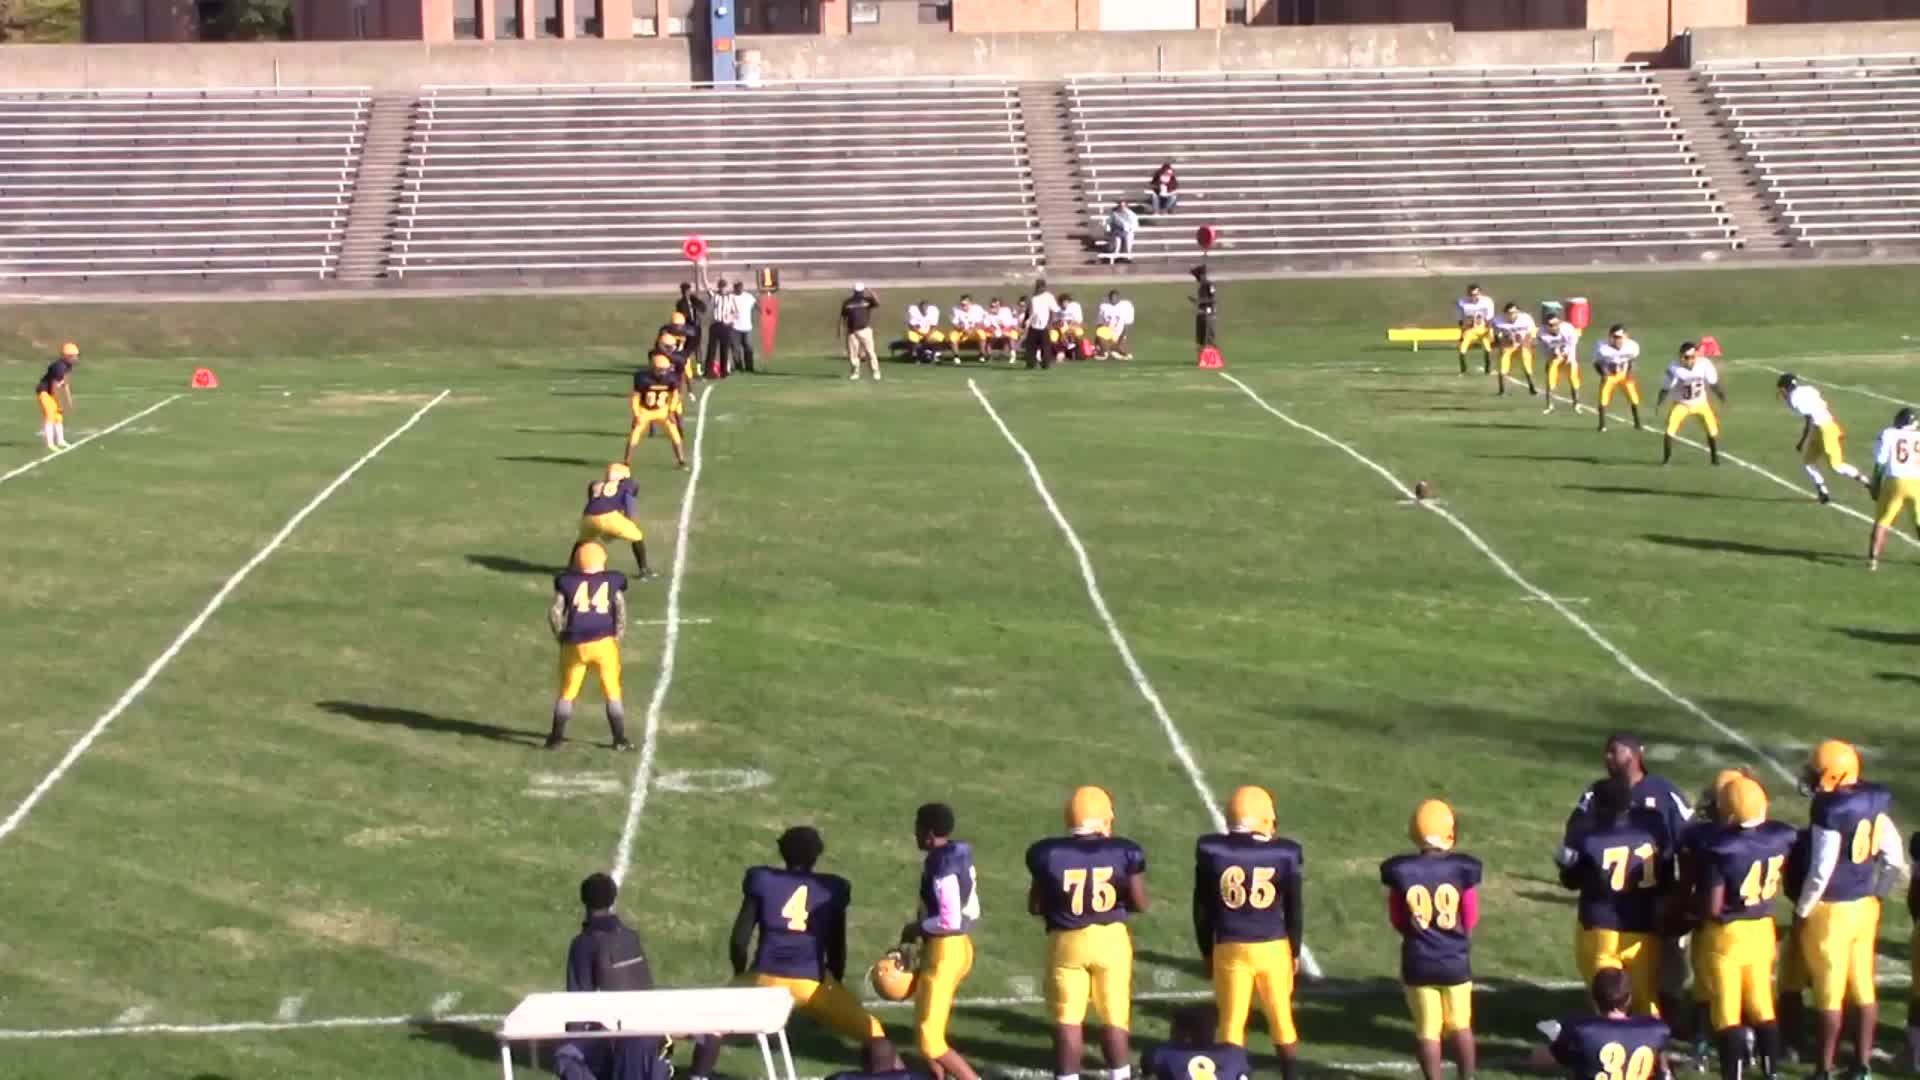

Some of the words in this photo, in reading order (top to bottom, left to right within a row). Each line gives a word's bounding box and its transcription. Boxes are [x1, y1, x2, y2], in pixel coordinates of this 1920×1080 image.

[573, 580, 610, 614] 44
[1219, 865, 1276, 909] 65
[1602, 843, 1657, 891] 71
[1739, 854, 1785, 907] 45
[781, 885, 809, 932] 4
[1063, 866, 1117, 916] 75
[1406, 883, 1460, 930] 99
[1594, 1041, 1655, 1080] 30
